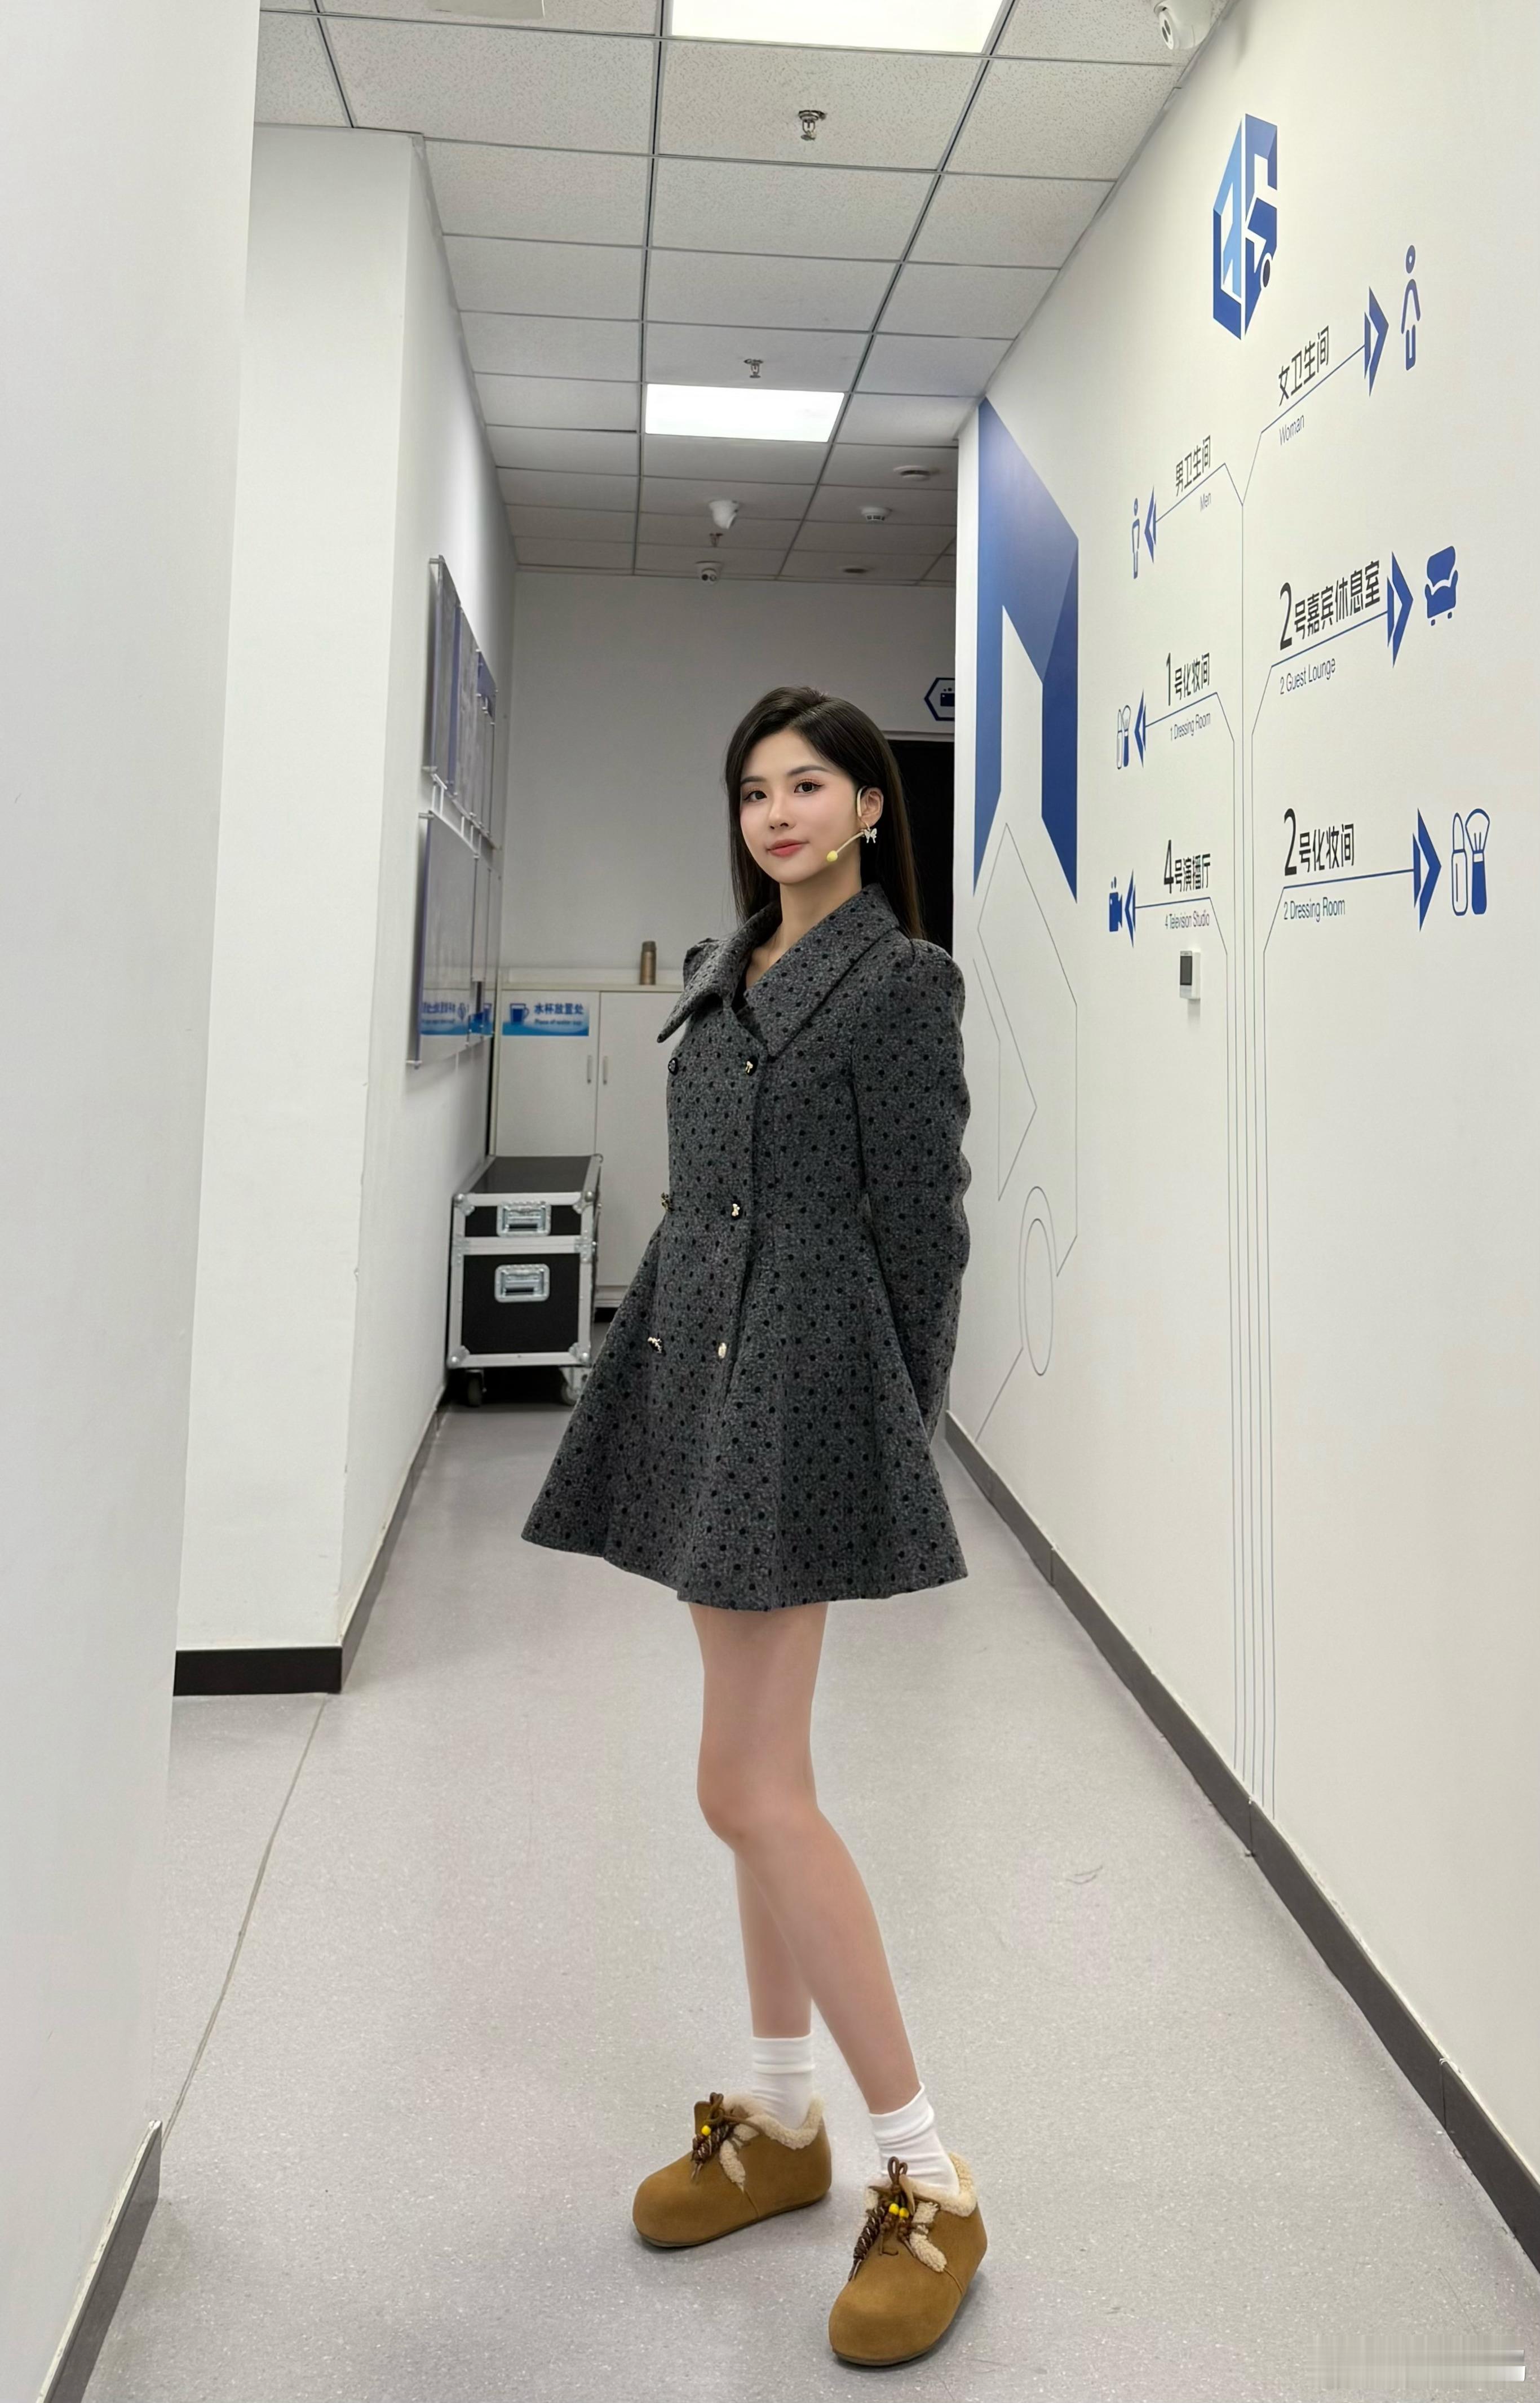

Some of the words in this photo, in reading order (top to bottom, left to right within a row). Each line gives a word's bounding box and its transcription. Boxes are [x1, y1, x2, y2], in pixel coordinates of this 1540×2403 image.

[1278, 325, 1329, 407] 女卫生间
[1279, 414, 1305, 446] Woman
[1175, 434, 1211, 497] 男卫生间
[1200, 492, 1212, 512] Men
[1280, 559, 1380, 651] 2号嘉宾休息室
[1166, 652, 1210, 707] 1号化妆间
[1280, 676, 1285, 695] 2
[1286, 667, 1307, 692] Guest
[1308, 658, 1336, 683] Lounge
[1170, 727, 1173, 742] 1
[1174, 719, 1194, 740] Dressing
[1195, 713, 1211, 732] Room
[1284, 808, 1355, 877] 2号化妆间
[1163, 839, 1211, 895] 4号演播厅
[1165, 914, 1169, 930] 4
[1169, 912, 1192, 930] Television
[1192, 909, 1210, 928] Studio
[1284, 901, 1288, 921] 2
[1290, 899, 1321, 923] Dressing
[1322, 896, 1346, 917] Room
[534, 1002, 585, 1015] 水杯放置处
